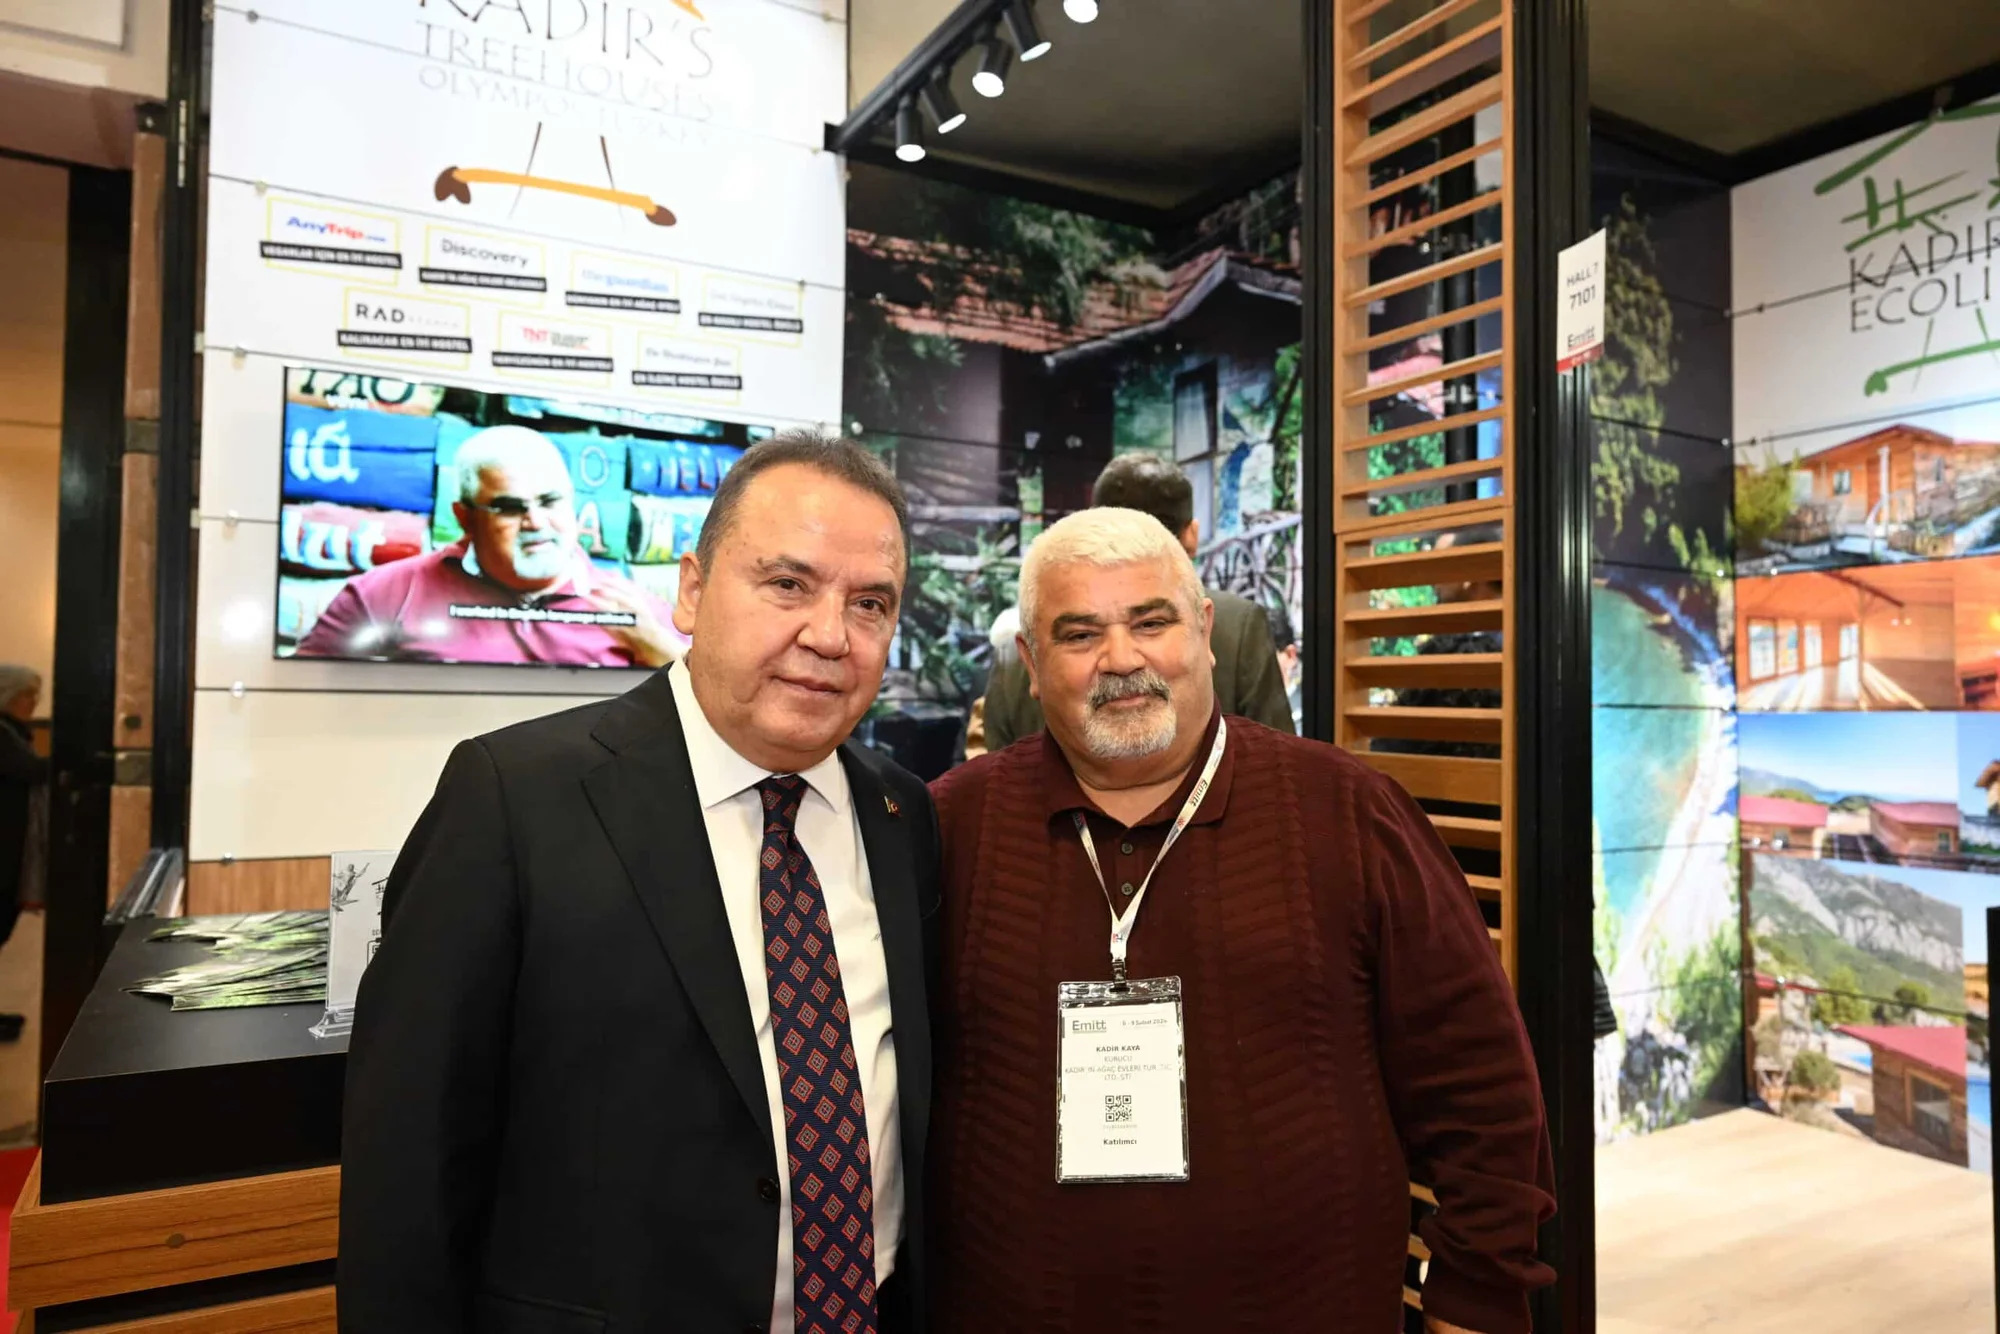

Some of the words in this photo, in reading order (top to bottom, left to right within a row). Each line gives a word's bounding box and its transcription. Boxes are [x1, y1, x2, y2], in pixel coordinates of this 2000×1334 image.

[420, 0, 713, 79] ADIR'S
[416, 20, 713, 122] TREEHOUSES
[441, 238, 528, 268] Discovery
[1566, 268, 1592, 288] HALL
[1593, 262, 1599, 275] 7
[1569, 284, 1596, 310] 7101
[355, 302, 405, 323] RAD
[522, 326, 549, 343] TNT
[1192, 779, 1208, 806] Emitt
[1072, 1019, 1107, 1031] Emitt
[1121, 1044, 1141, 1052] KAYA
